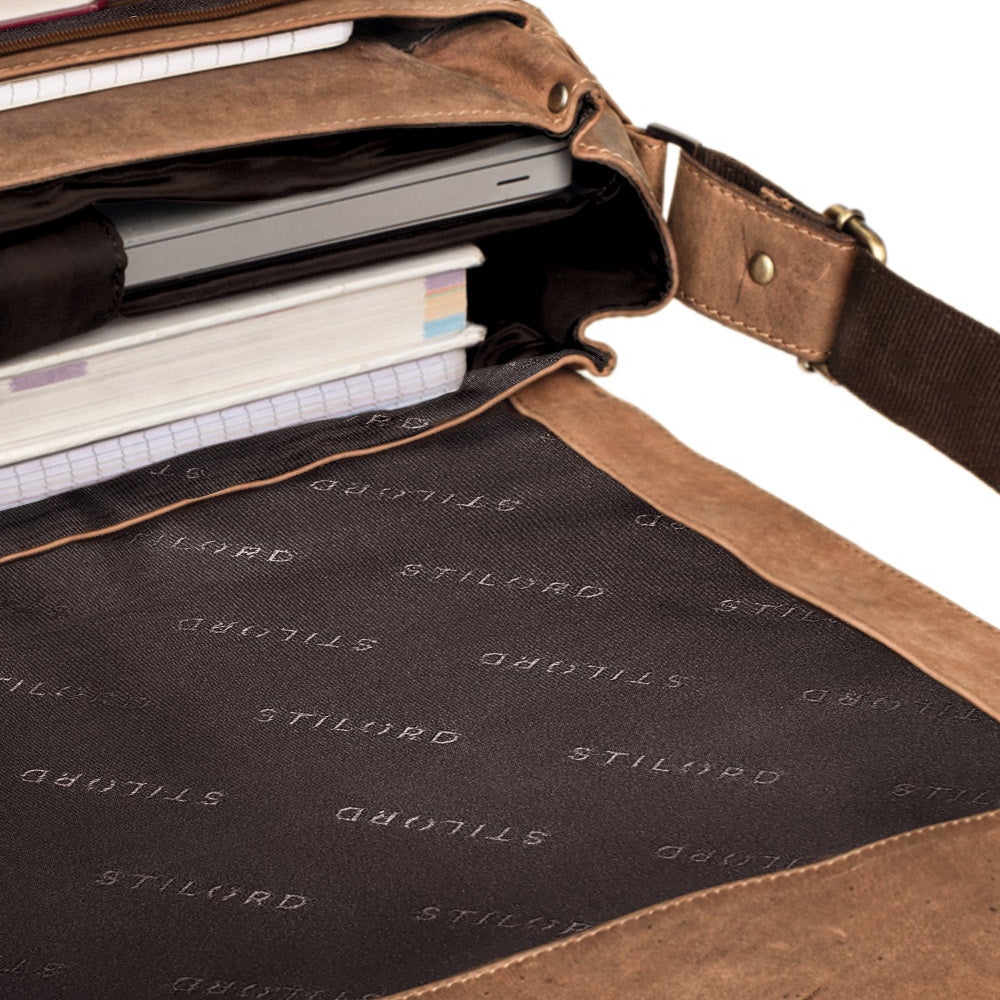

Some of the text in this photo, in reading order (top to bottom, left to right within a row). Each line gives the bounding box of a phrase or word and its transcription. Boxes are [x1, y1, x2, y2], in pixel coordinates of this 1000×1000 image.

[400, 563, 607, 599] STILORD
[176, 617, 381, 652] STILORD
[481, 652, 690, 689] STILORD
[253, 708, 464, 745] STILORD
[567, 746, 784, 786] STILORD
[18, 768, 226, 806] STILORD
[334, 805, 552, 846] STILORD
[96, 869, 308, 910] STILORD
[415, 905, 592, 936] STILOR
